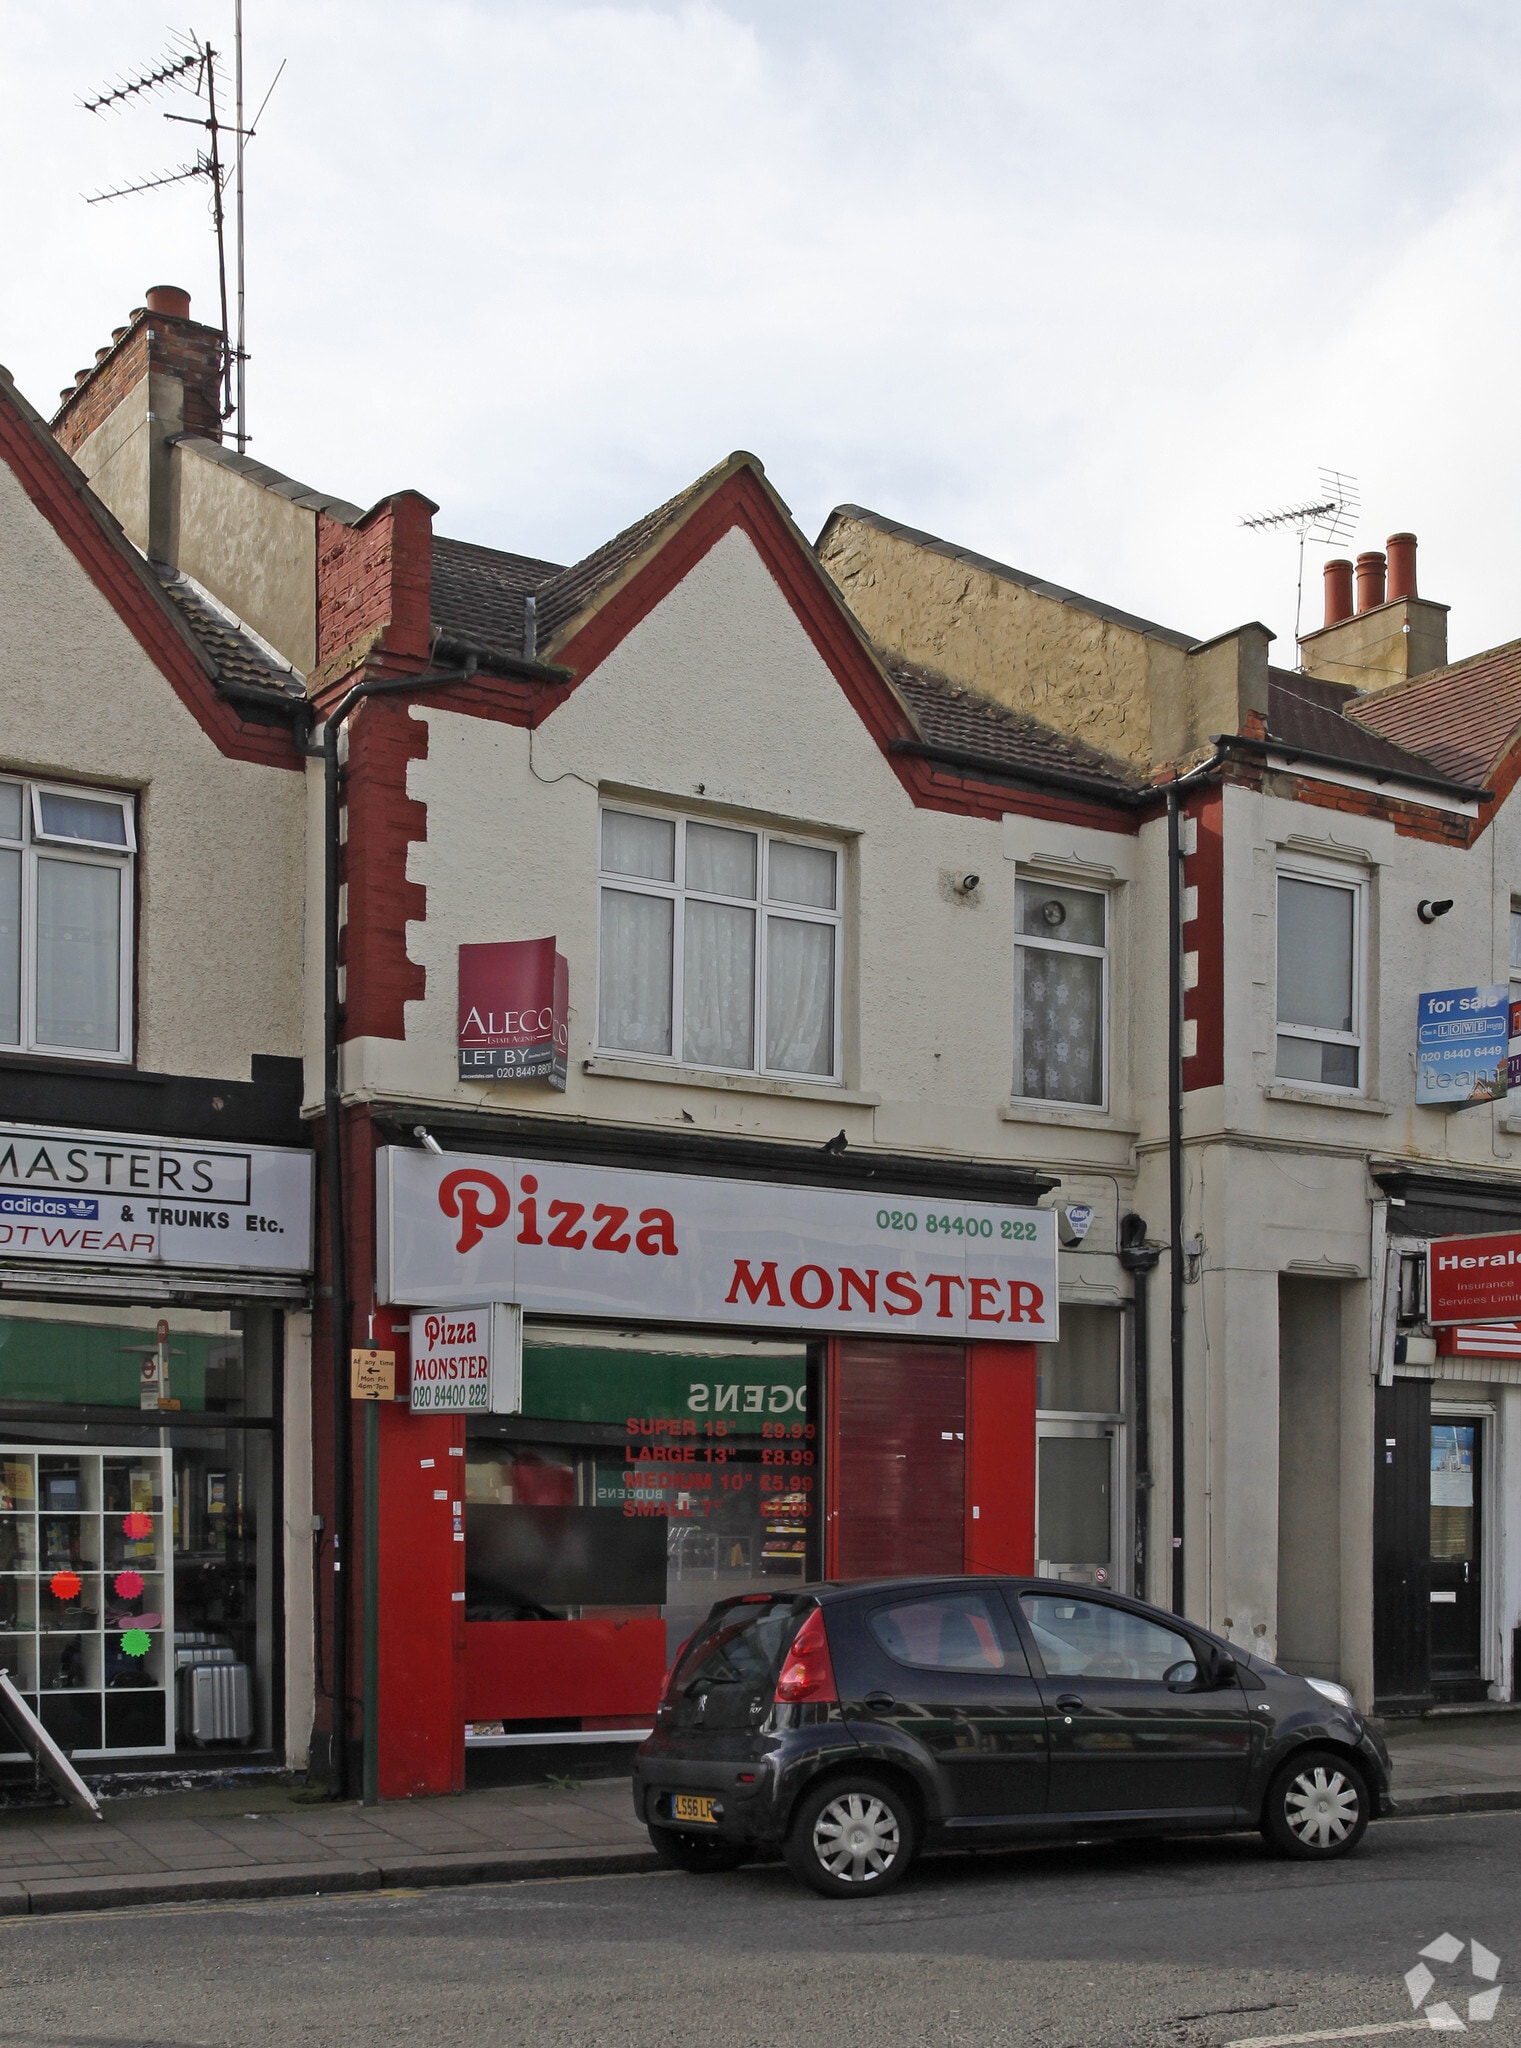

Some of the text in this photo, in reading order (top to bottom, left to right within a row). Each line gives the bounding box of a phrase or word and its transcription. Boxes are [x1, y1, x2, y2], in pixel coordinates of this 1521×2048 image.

[1428, 993, 1499, 1014] for sale
[460, 1006, 553, 1035] ALECO
[1441, 1022, 1484, 1035] LOWE
[462, 1050, 497, 1065] LET
[504, 1048, 530, 1064] BY
[1421, 1045, 1502, 1062] 020 8440 6449
[496, 1068, 514, 1079] 020
[515, 1065, 536, 1077] 8449
[1423, 1067, 1500, 1090] team
[1, 1198, 285, 1233] adidas & TRUNKS Etc.
[438, 1168, 679, 1256] Pizza
[876, 1209, 1037, 1242] 020 84400 222
[725, 1258, 1046, 1325] MONSTER
[1457, 1280, 1514, 1291] Insurance
[1438, 1293, 1521, 1307] Services Limit
[424, 1315, 477, 1352] Pizza
[413, 1355, 488, 1381] MONSTER
[413, 1383, 488, 1407] 020 84400 222
[625, 1417, 697, 1436] SUPER
[762, 1421, 816, 1439] £9.99
[625, 1445, 697, 1463] LARGE
[761, 1448, 815, 1465] £8.99
[625, 1472, 712, 1490] MEDIUM
[760, 1474, 813, 1492] £5.99
[623, 1500, 695, 1517] SMALL
[760, 1500, 813, 1518] £2.00
